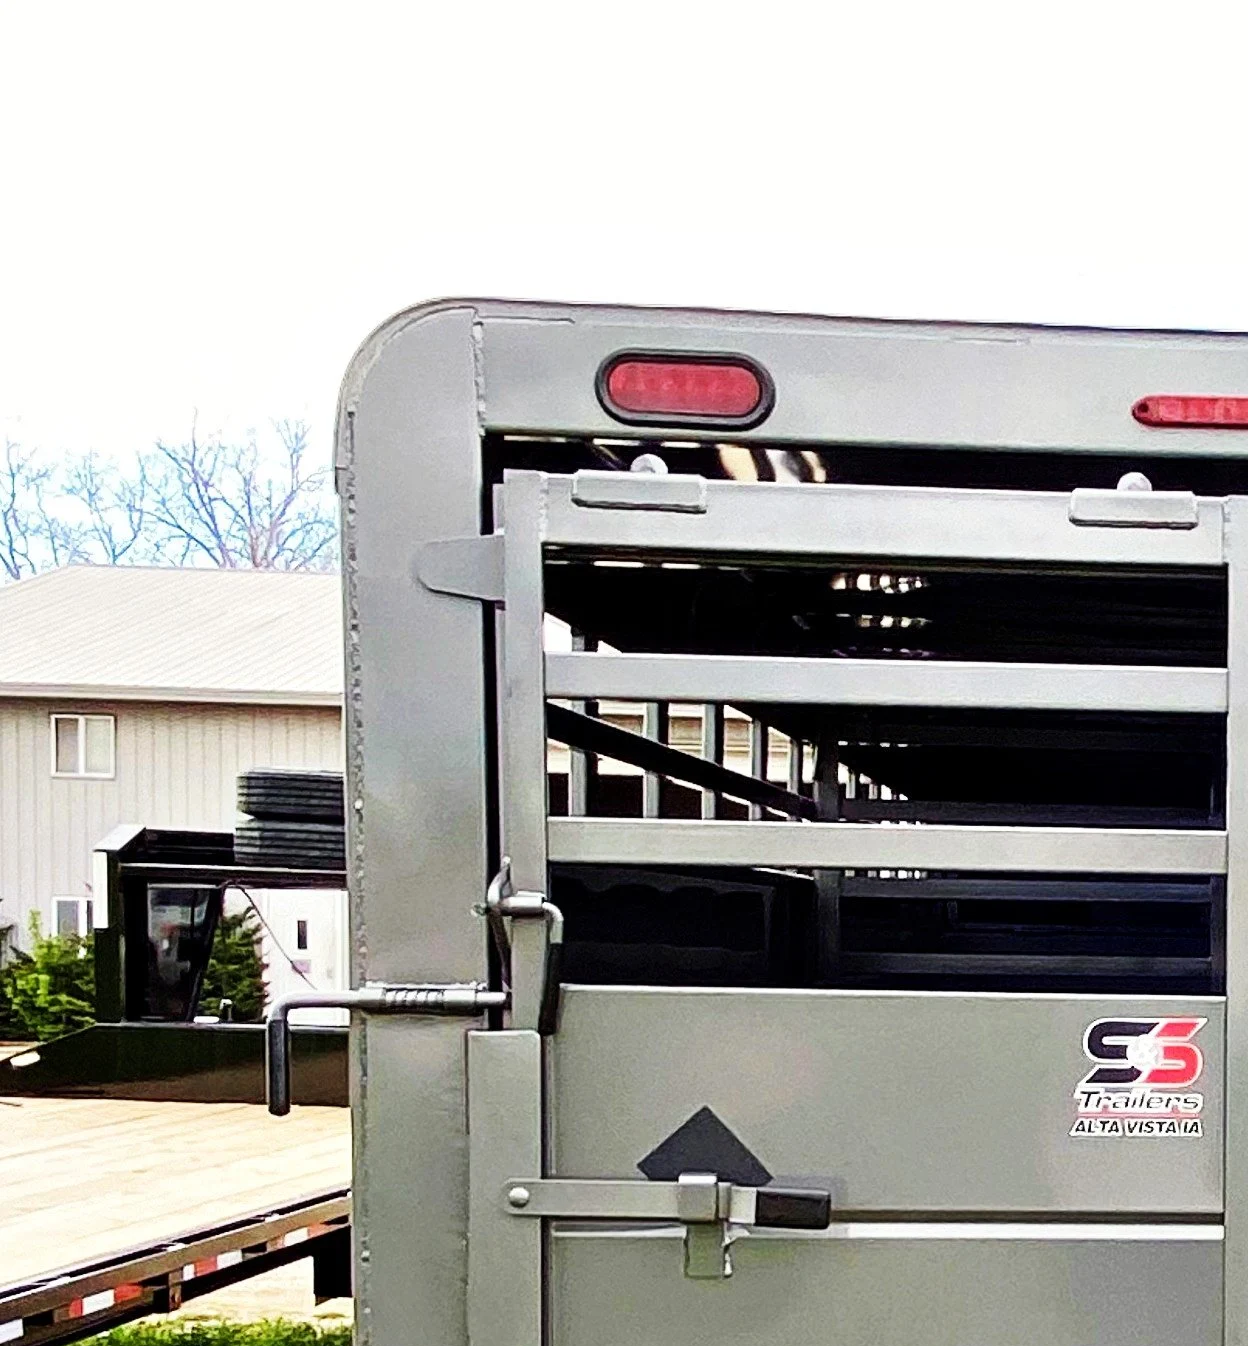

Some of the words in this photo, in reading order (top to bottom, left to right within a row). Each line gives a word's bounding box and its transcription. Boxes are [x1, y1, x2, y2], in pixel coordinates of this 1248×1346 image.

[1079, 1090, 1200, 1110] Trailers
[1074, 1120, 1121, 1134] ALTA
[1126, 1120, 1178, 1134] VISTA
[1182, 1120, 1200, 1134] IA
